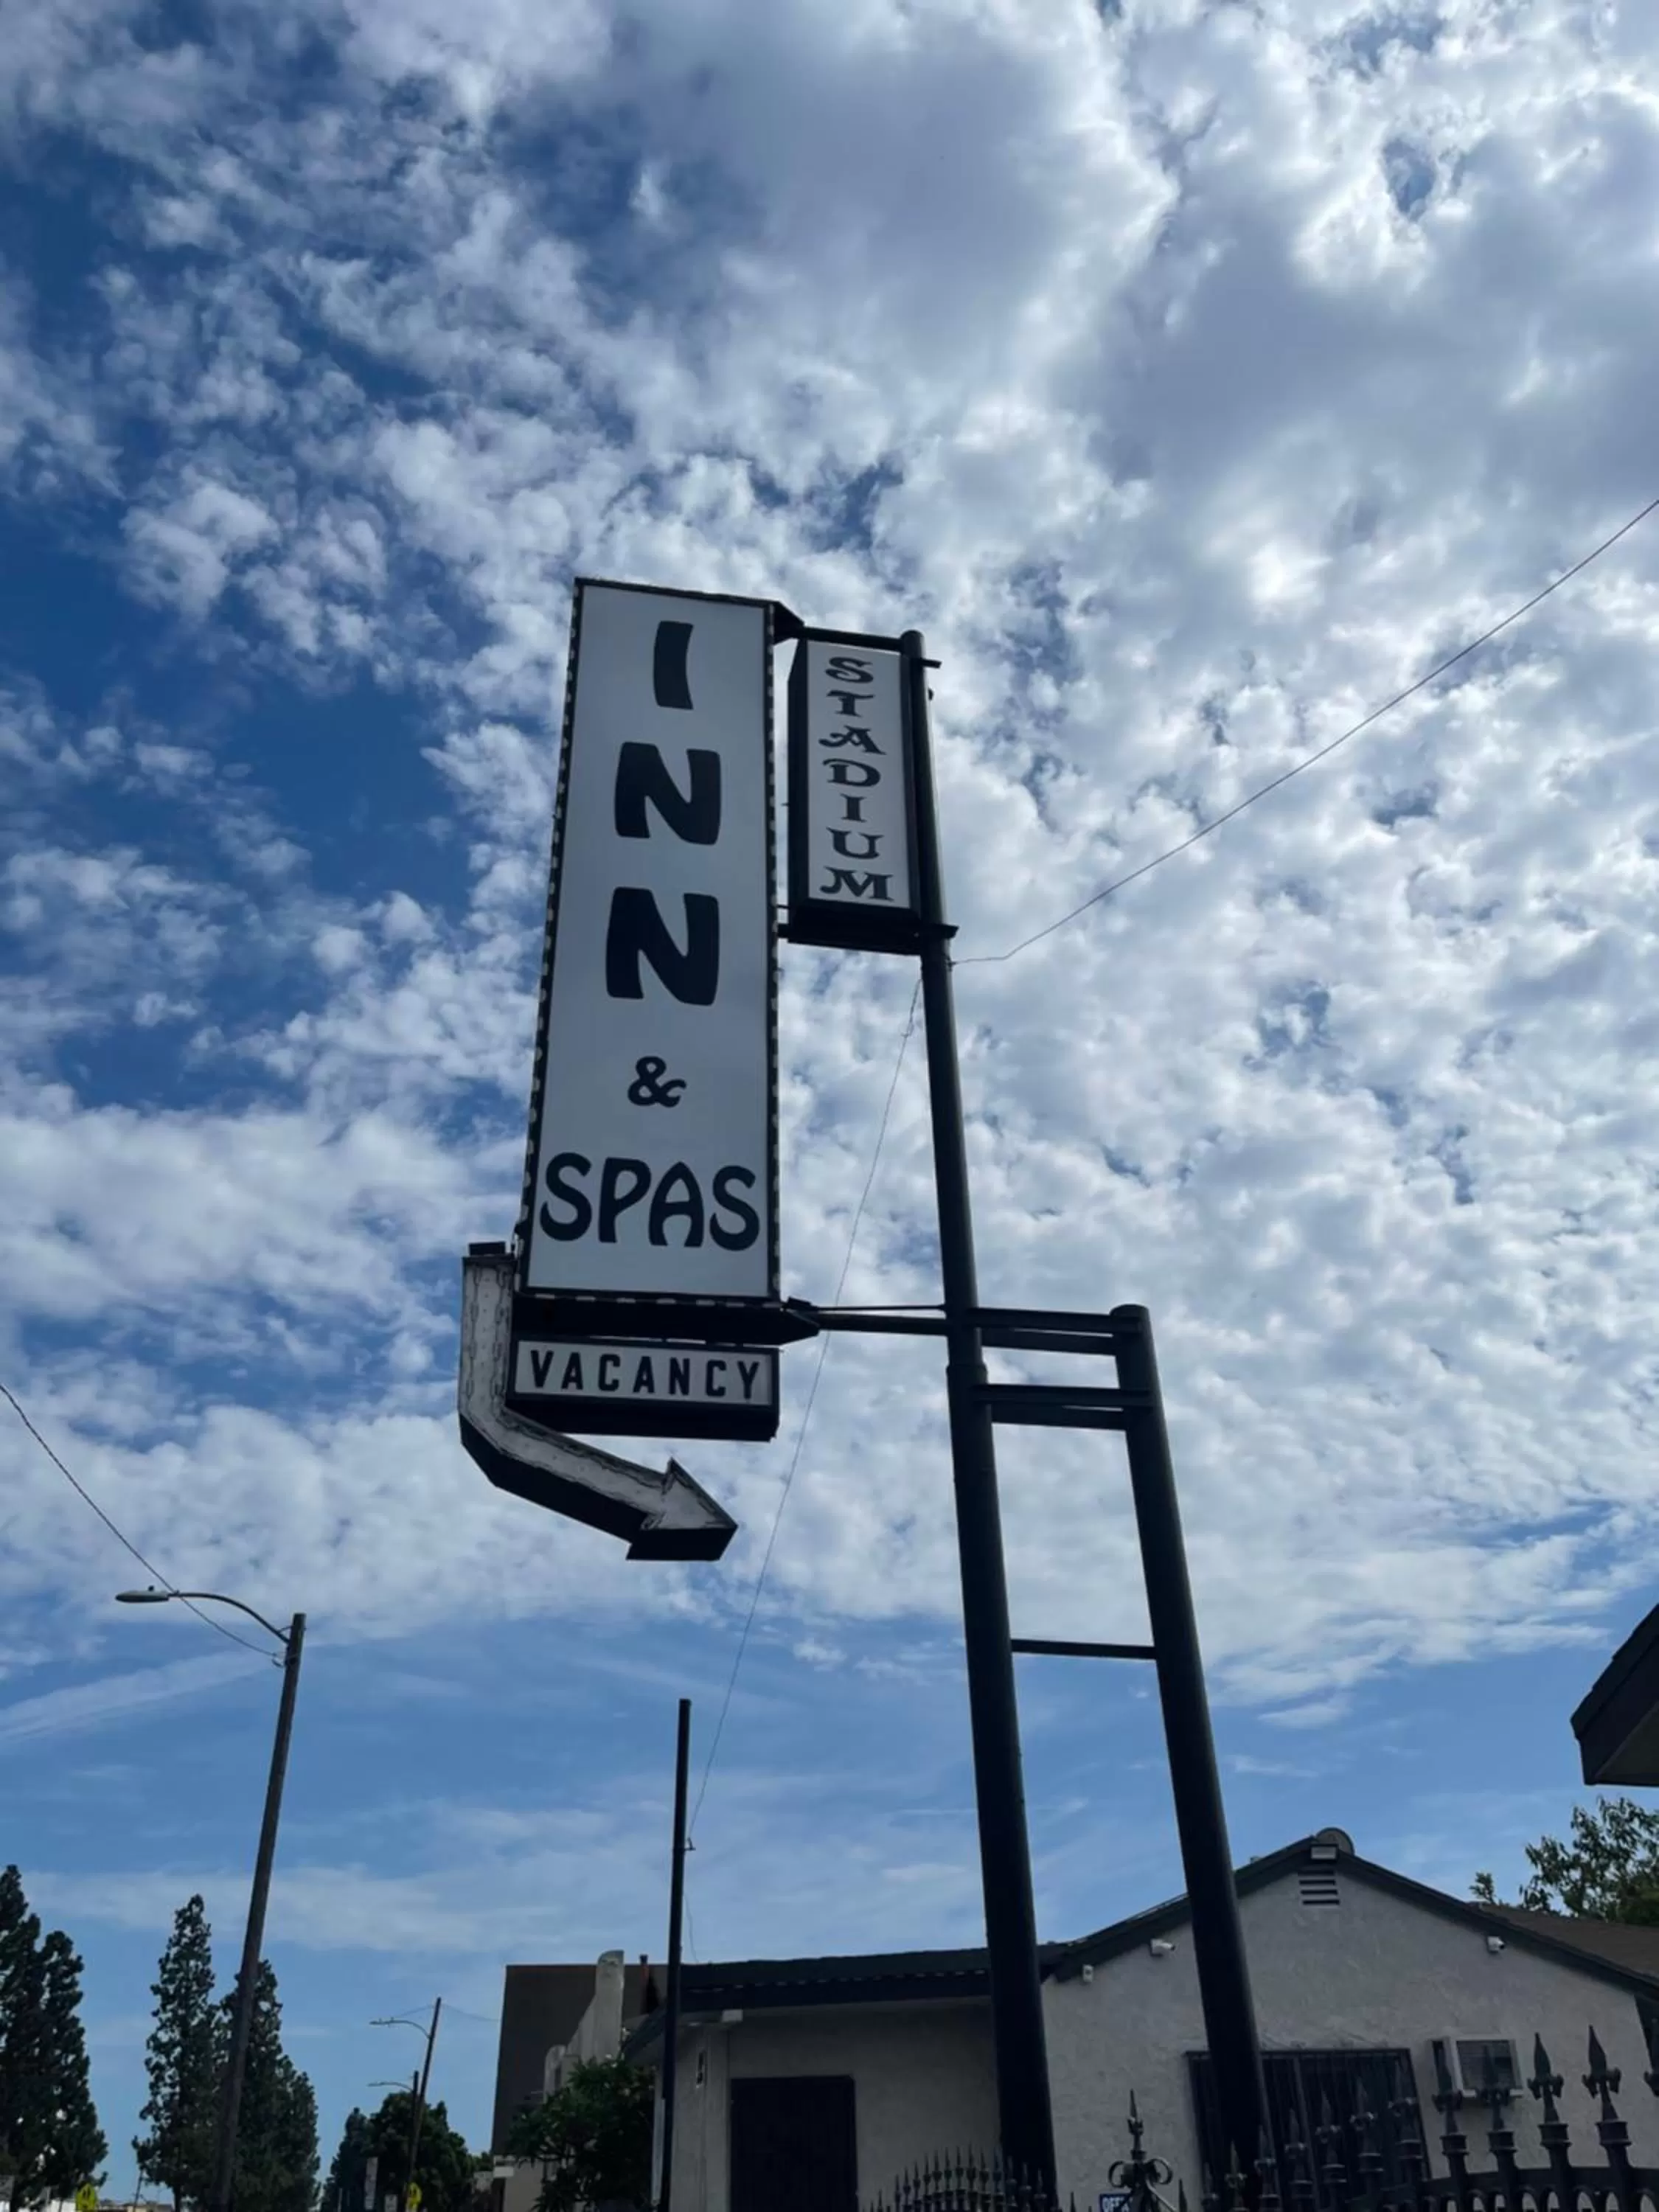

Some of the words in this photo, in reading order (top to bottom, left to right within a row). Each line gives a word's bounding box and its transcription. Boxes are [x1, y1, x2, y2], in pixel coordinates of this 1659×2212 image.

[605, 620, 721, 1006] INN
[818, 656, 893, 901] STADIUM
[627, 1056, 687, 1108] &
[539, 1152, 760, 1251] SPAS
[530, 1349, 759, 1400] VACANCY
